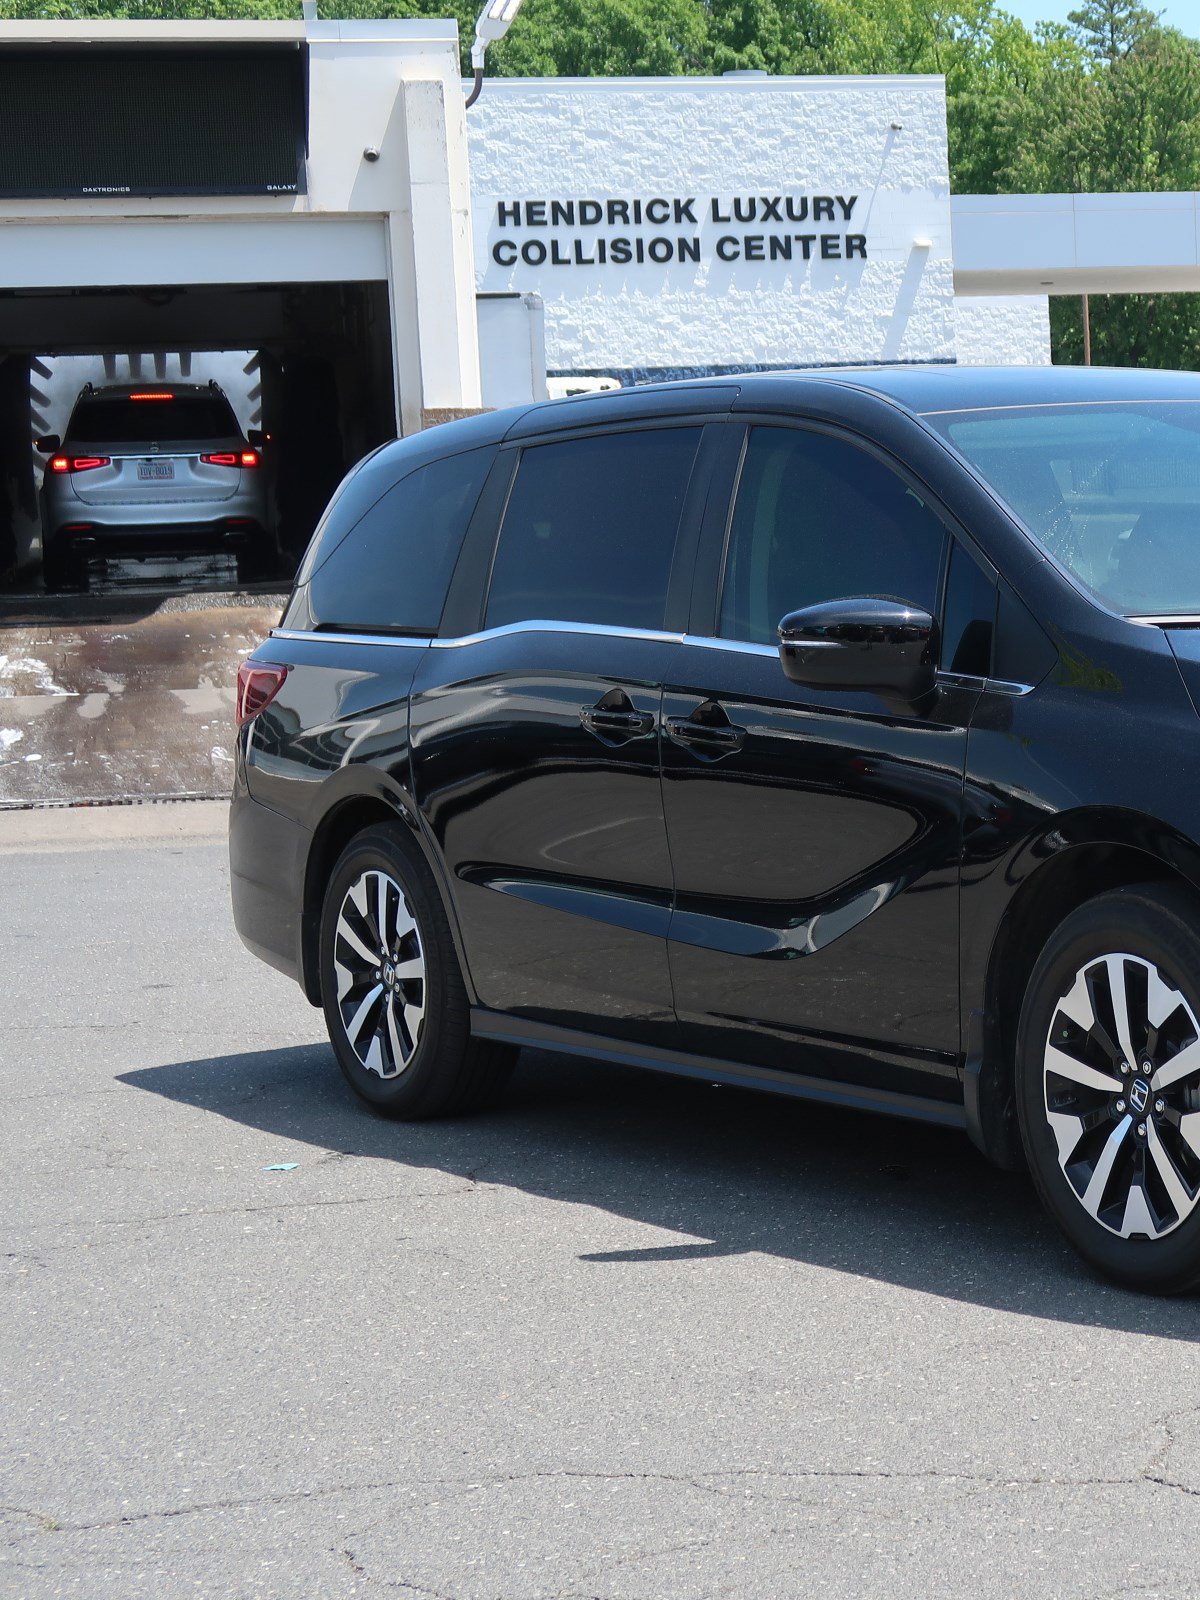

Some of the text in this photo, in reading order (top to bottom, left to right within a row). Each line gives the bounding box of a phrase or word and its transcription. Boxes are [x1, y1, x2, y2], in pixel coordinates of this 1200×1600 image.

[497, 195, 858, 227] HENDRICK LUXURY
[492, 233, 868, 267] COLLISION CENTER
